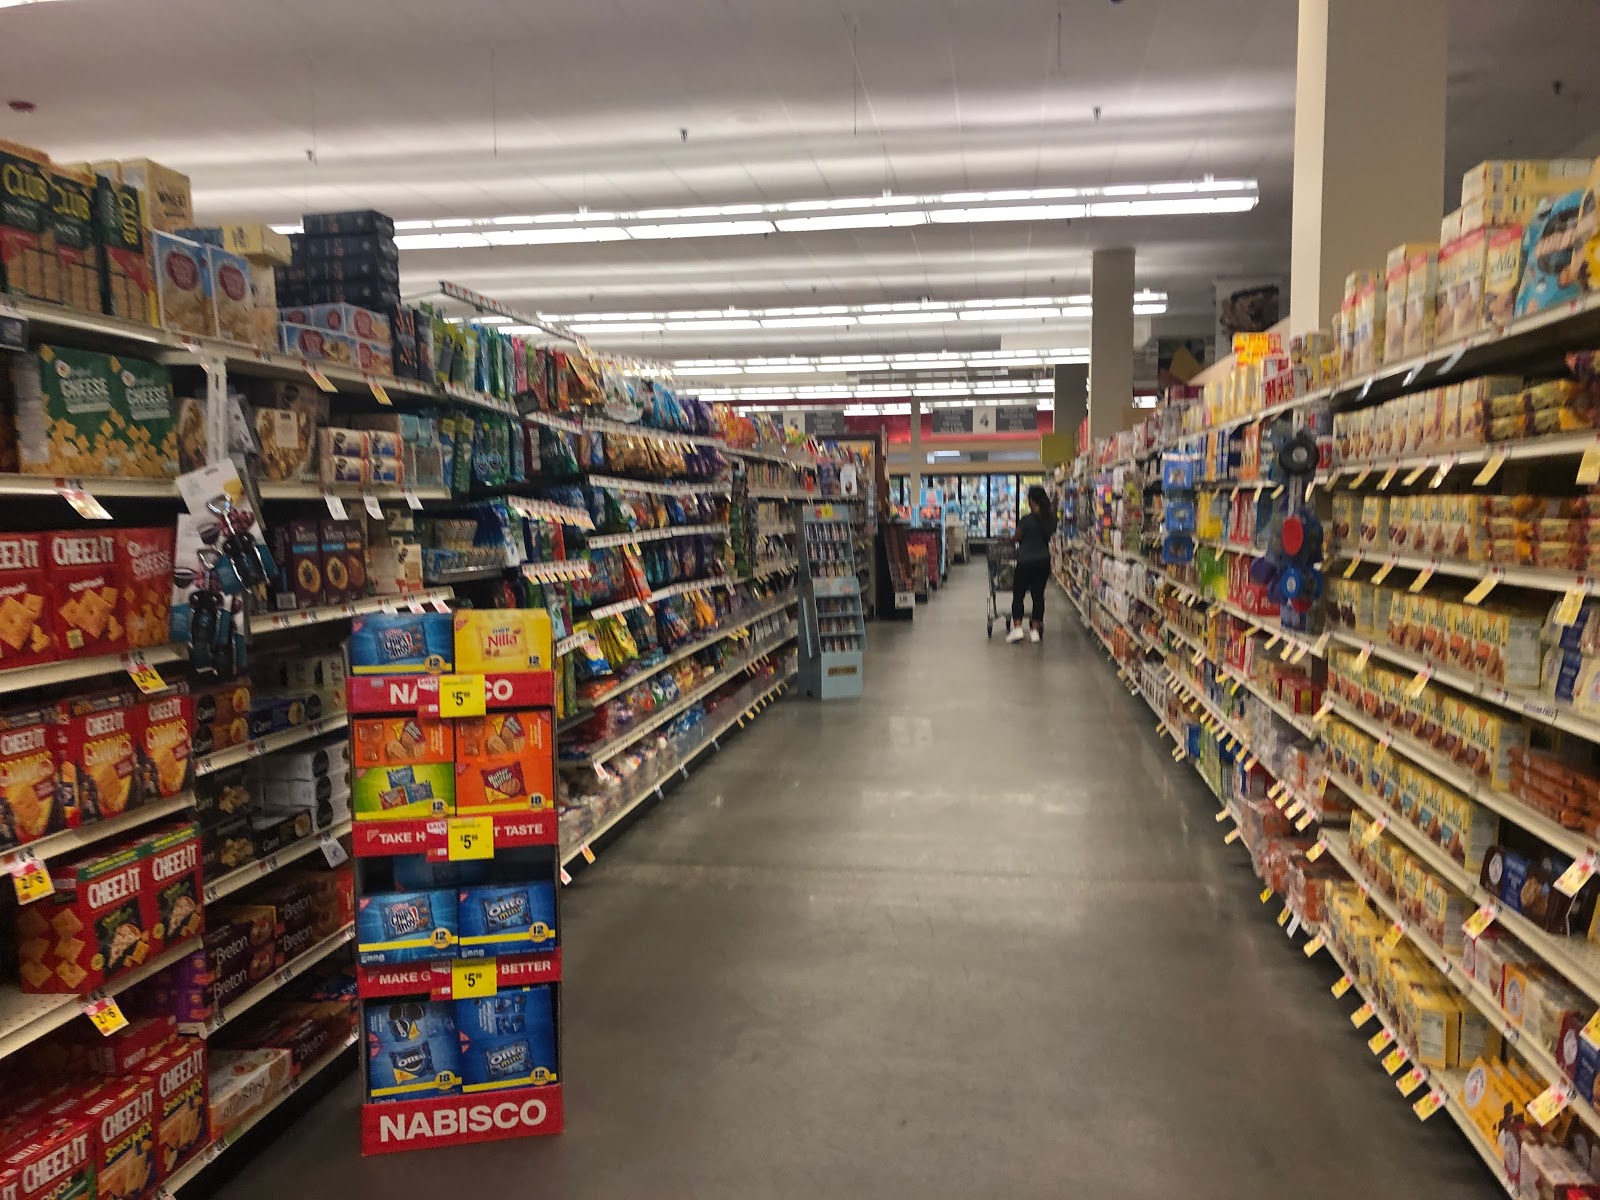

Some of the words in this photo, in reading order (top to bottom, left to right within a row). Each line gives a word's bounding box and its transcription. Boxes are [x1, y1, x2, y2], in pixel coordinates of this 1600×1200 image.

[504, 823, 543, 837] TASTE
[379, 831, 412, 845] TAKE
[501, 960, 551, 975] BETTER
[379, 969, 418, 985] MAKE
[380, 1099, 547, 1143] NABISCO
